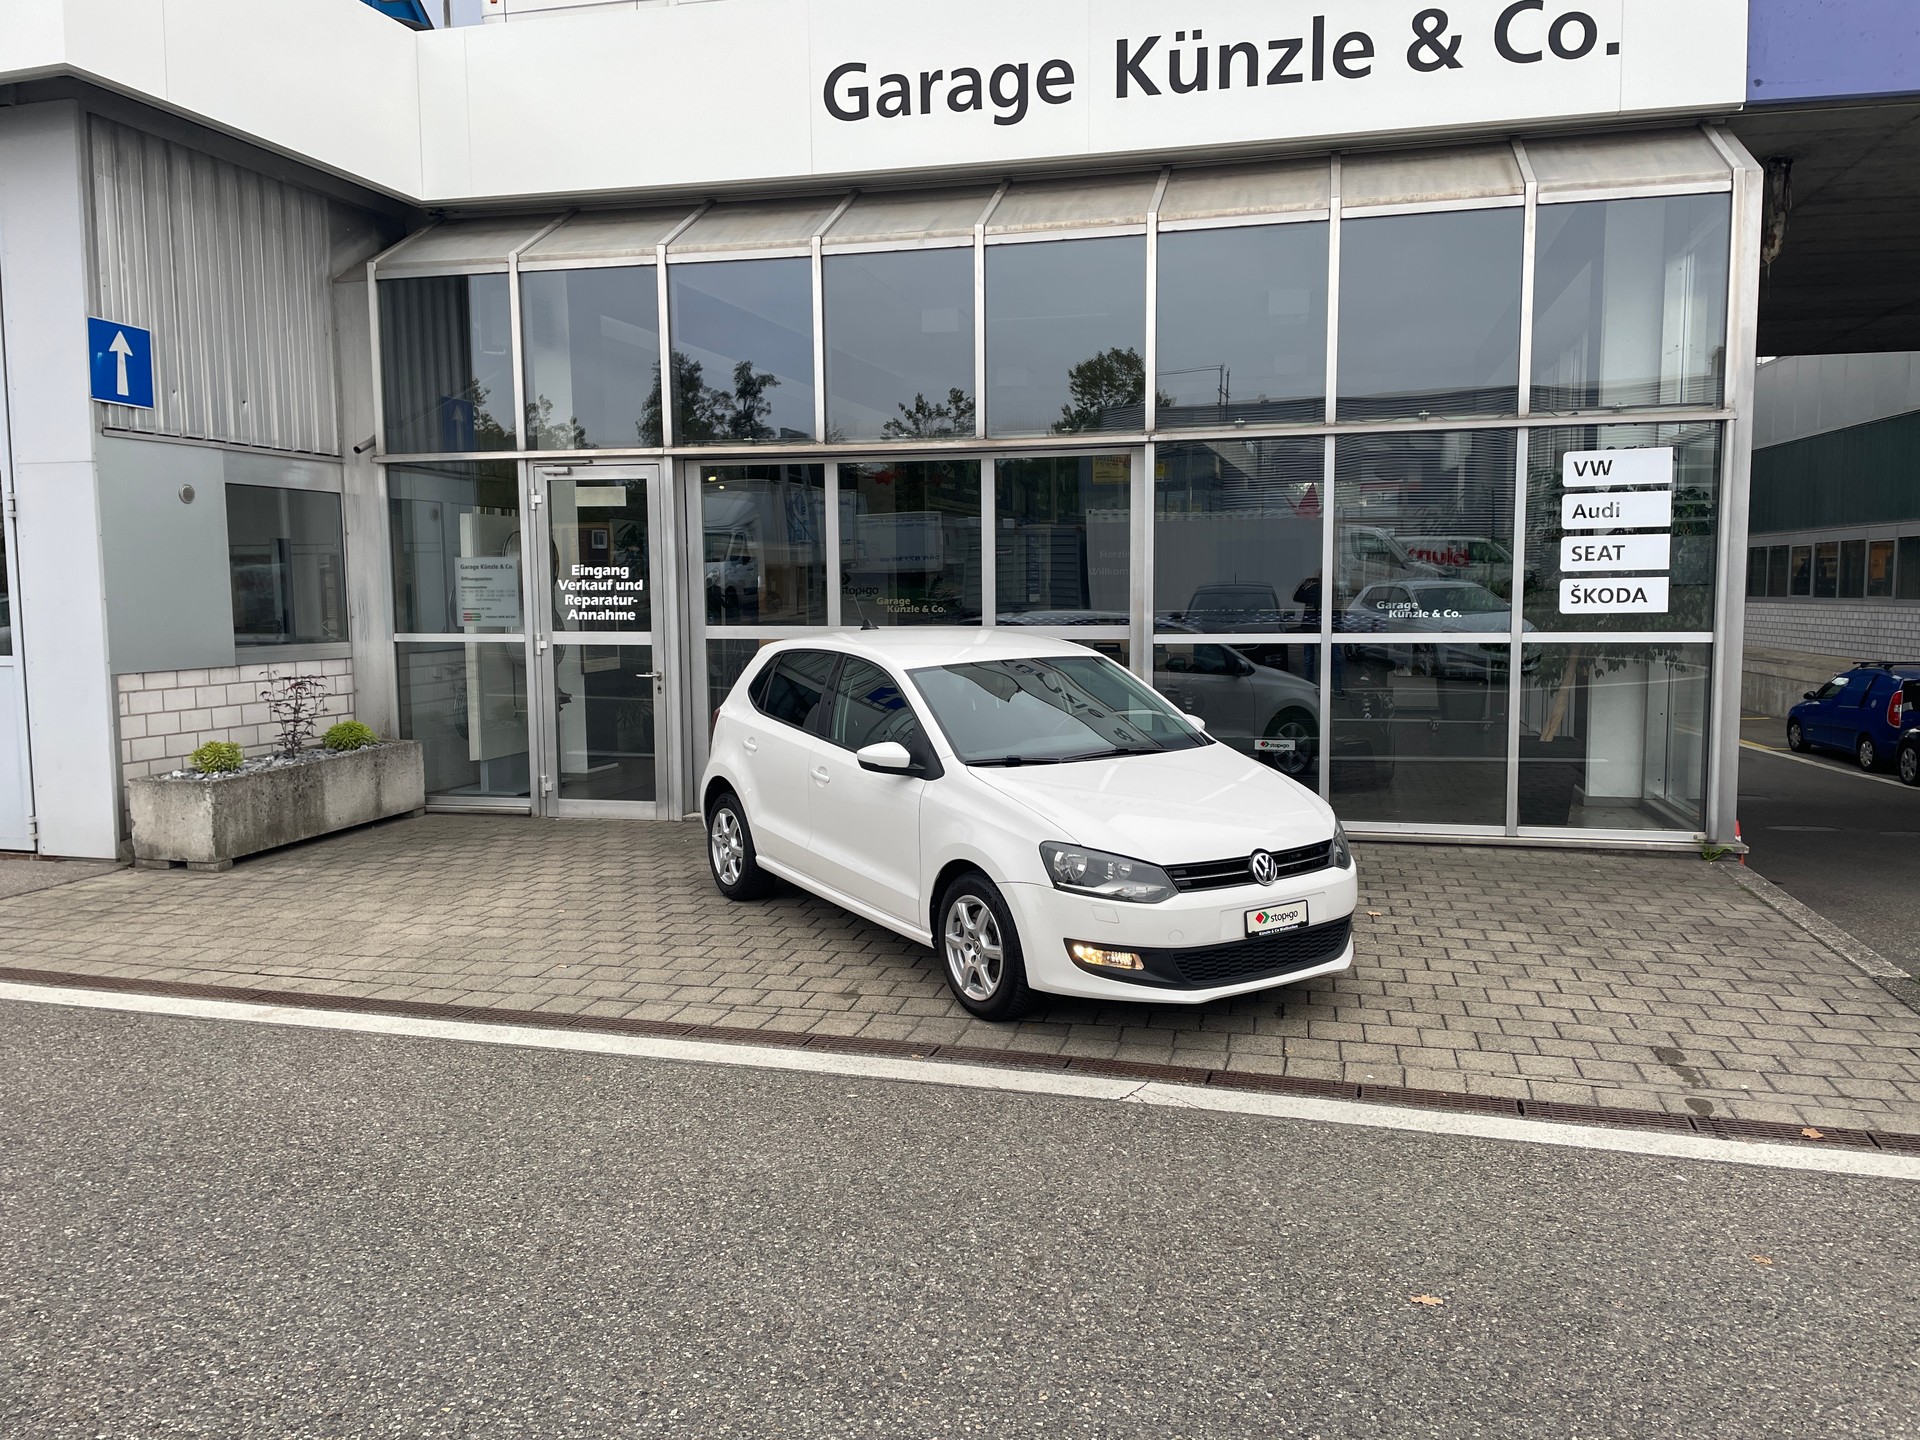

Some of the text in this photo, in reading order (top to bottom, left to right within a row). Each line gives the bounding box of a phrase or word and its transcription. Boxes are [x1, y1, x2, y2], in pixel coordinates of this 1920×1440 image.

[823, 0, 1621, 126] Garage Künzle & Co.
[1572, 459, 1613, 477] VW
[1571, 501, 1621, 519] Audi
[1571, 544, 1626, 562] SEAT
[571, 564, 630, 579] Eingang
[557, 579, 644, 591] Verkauf und
[841, 586, 879, 597] stop+go
[1570, 584, 1648, 604] ŠKODA
[564, 594, 638, 609] Reparatur-
[876, 597, 911, 606] Garage
[1376, 601, 1418, 611] Garage
[566, 608, 636, 620] Annahme
[887, 604, 947, 613] Künzle & Co.
[1388, 609, 1463, 618] Künzle & Co.
[1270, 910, 1299, 923] stop+go
